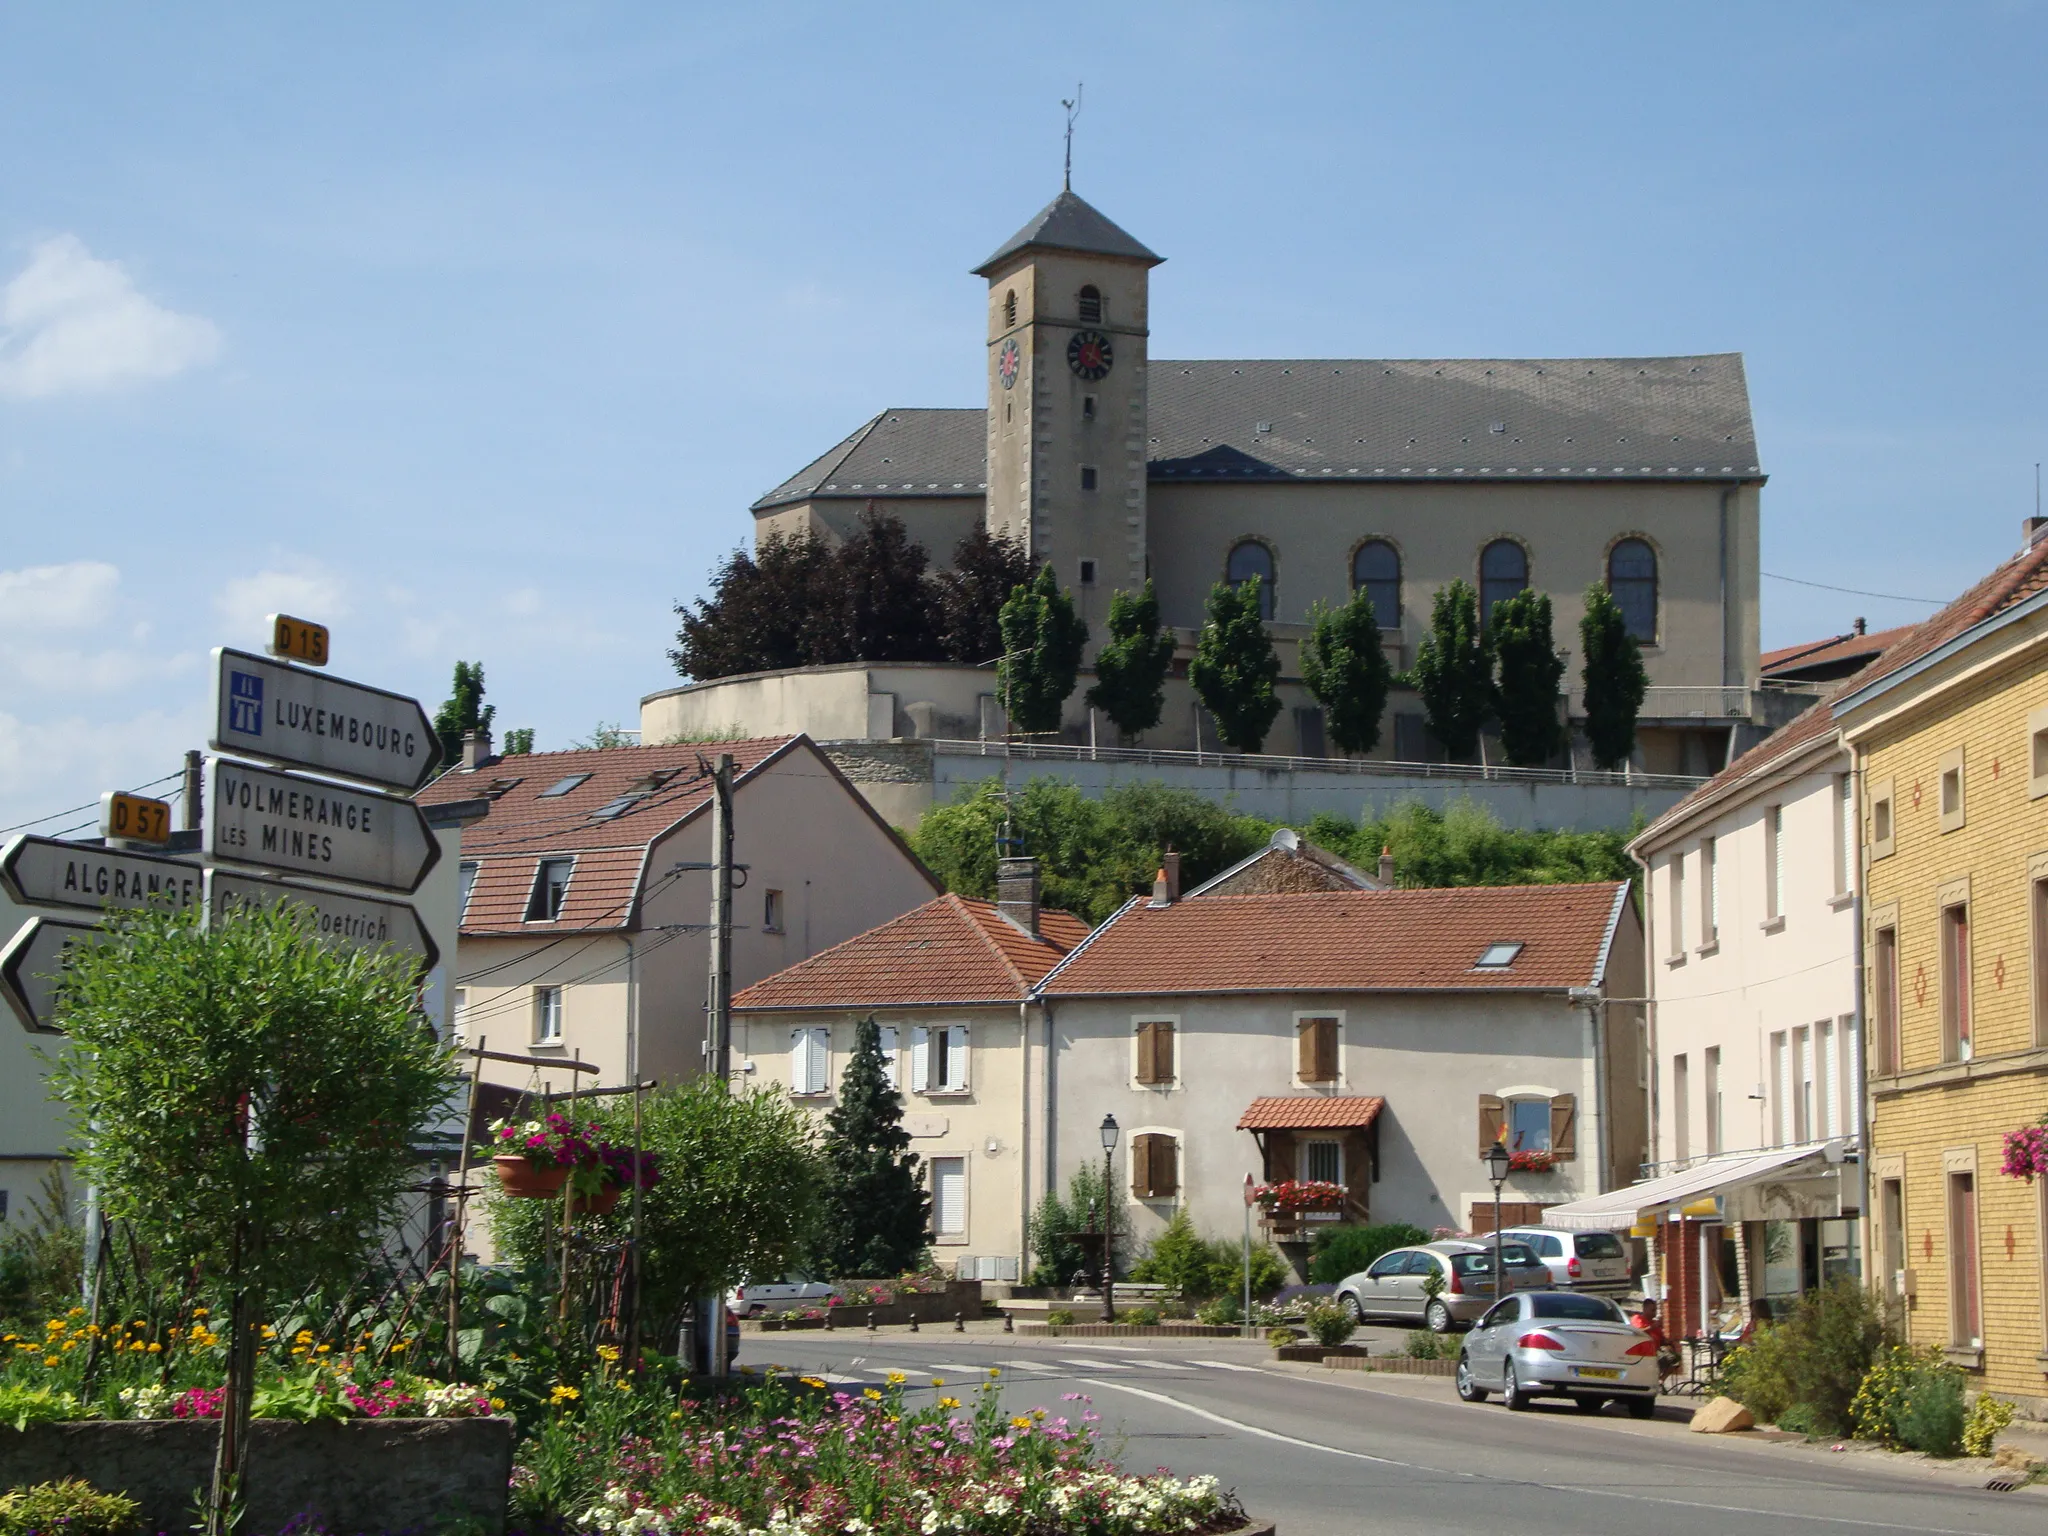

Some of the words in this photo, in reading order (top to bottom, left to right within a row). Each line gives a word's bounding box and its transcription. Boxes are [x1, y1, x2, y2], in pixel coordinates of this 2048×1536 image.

[280, 624, 291, 649] D
[300, 629, 322, 658] 15
[276, 699, 414, 757] LUXEMBOURG
[116, 803, 128, 830] D
[137, 806, 166, 837] 57
[225, 779, 371, 833] VOLMERANGE
[262, 824, 332, 862] MINES
[64, 861, 193, 907] ALGRANGE
